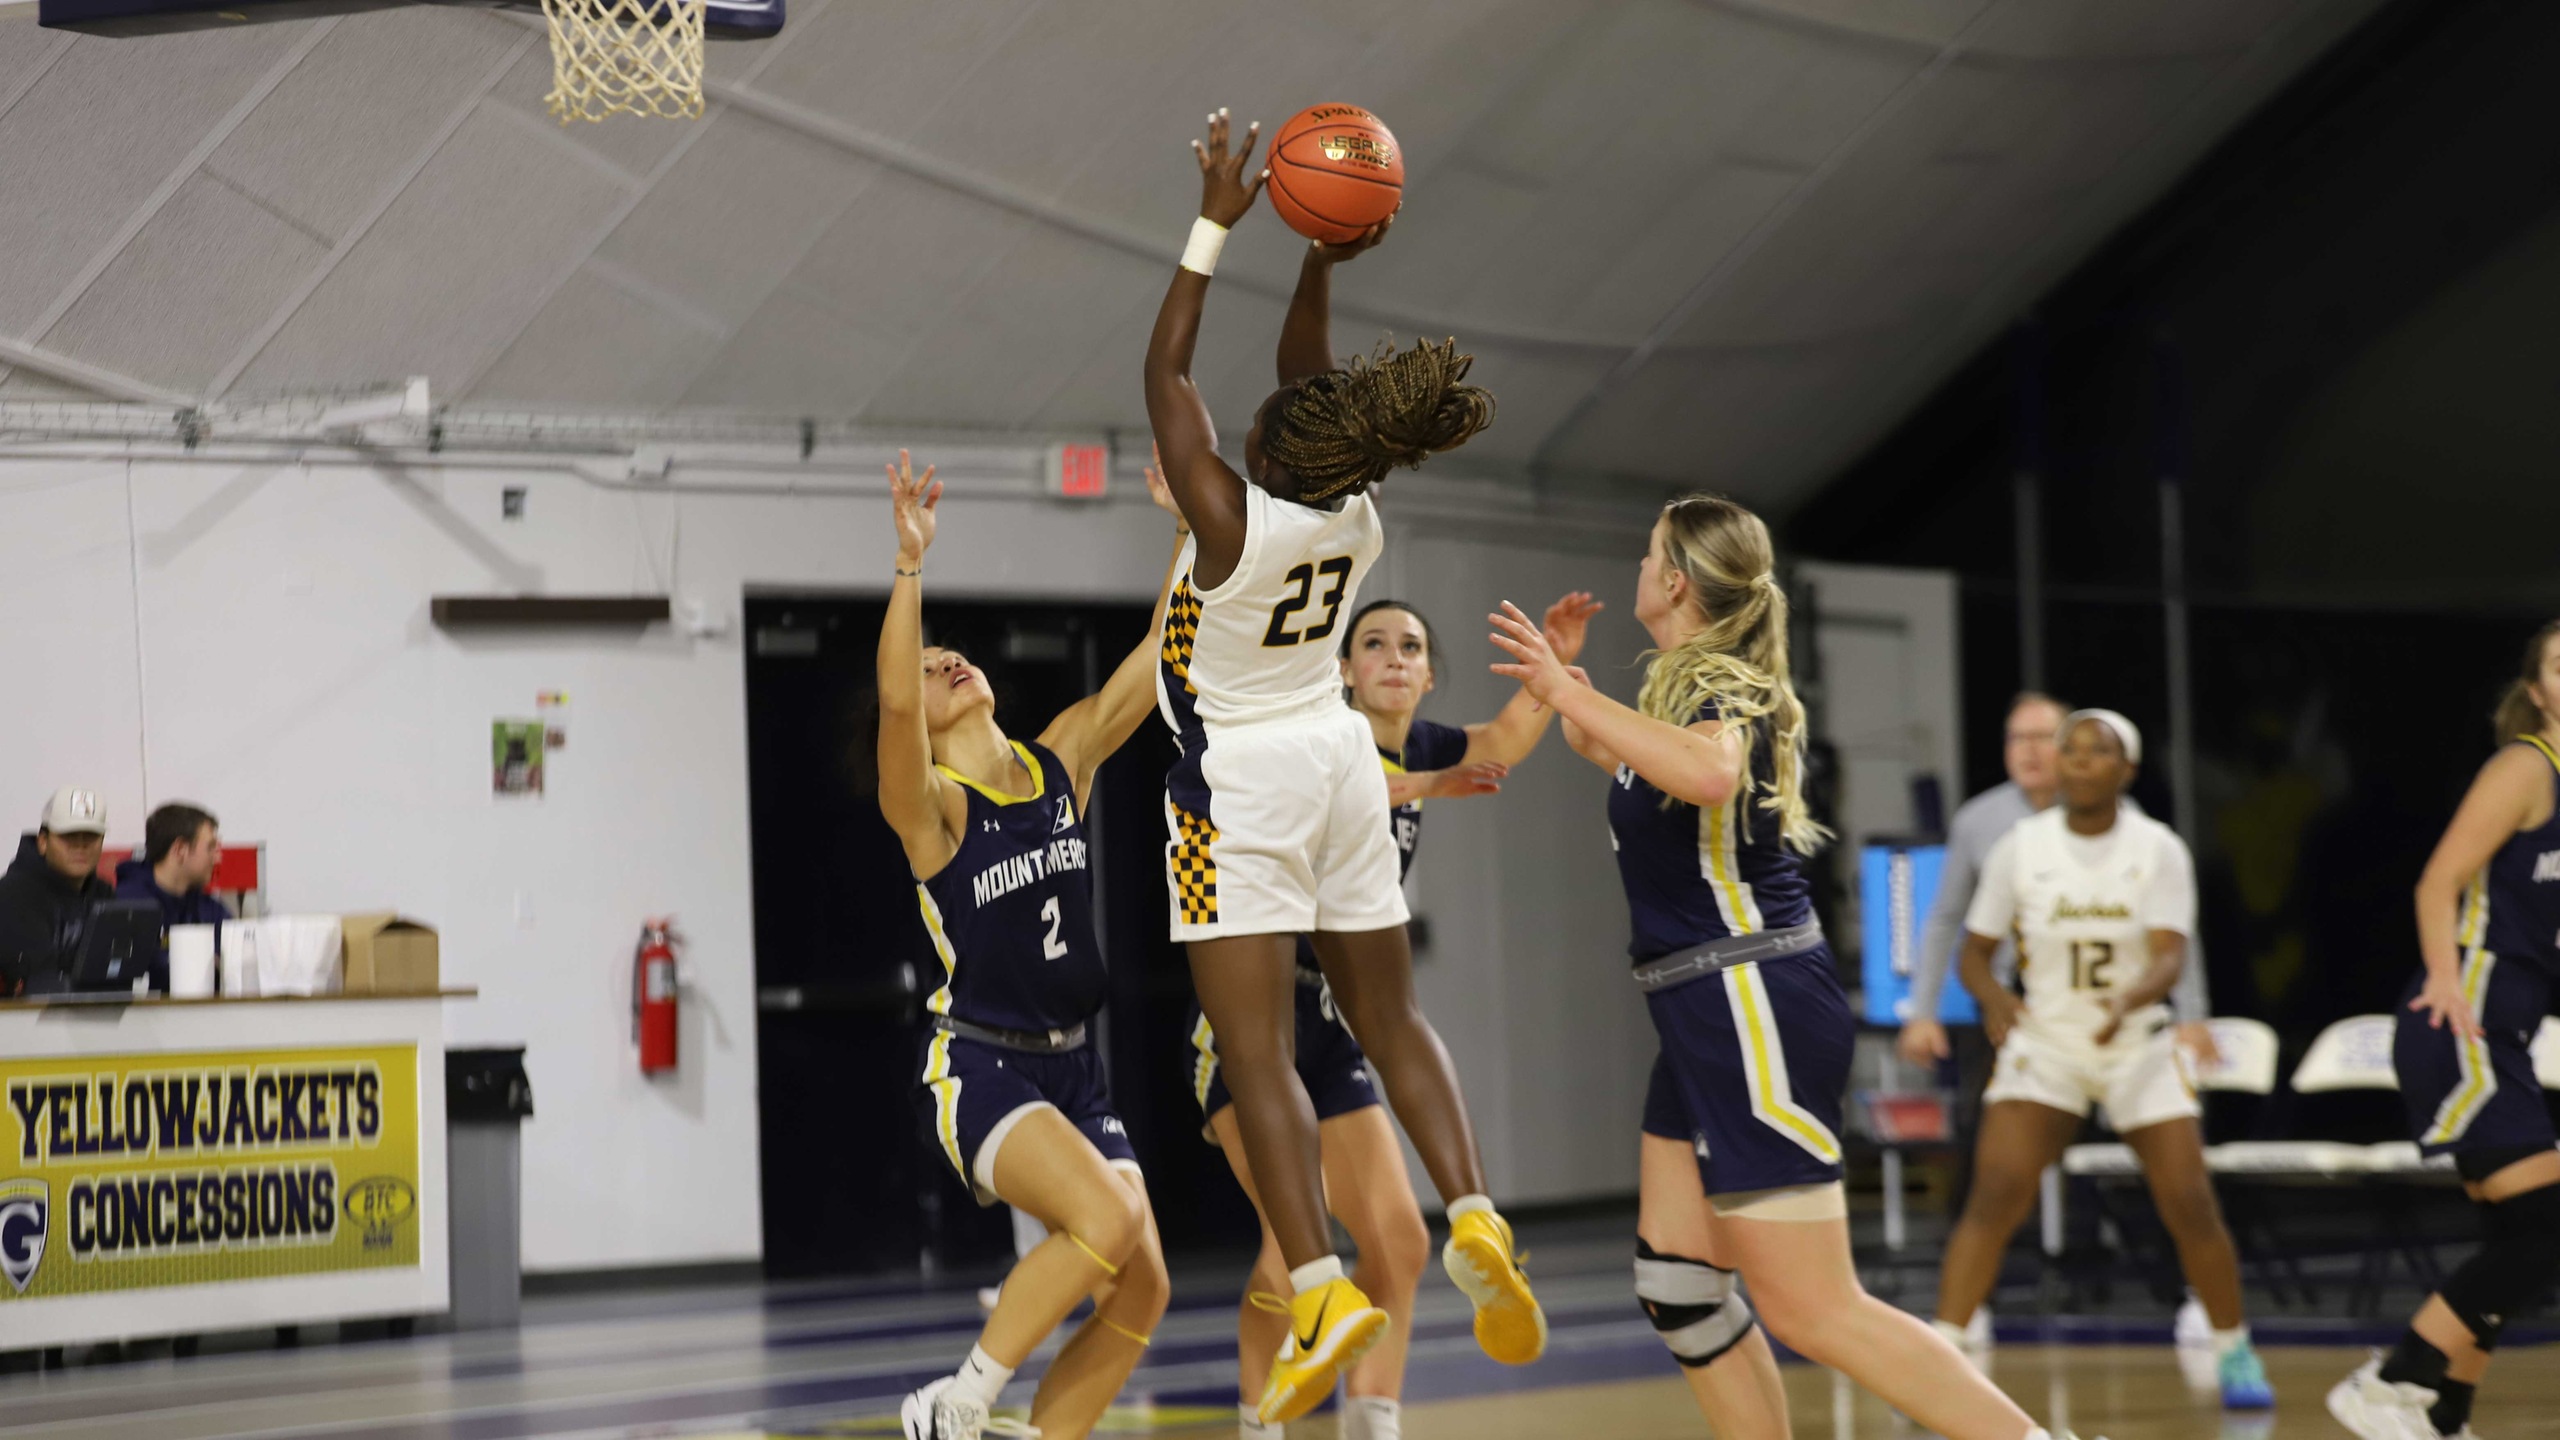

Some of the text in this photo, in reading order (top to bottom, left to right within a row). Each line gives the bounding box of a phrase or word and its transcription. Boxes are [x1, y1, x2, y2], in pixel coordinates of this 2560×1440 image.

[1260, 555, 1353, 647] 23
[973, 848, 1044, 909] MOUNT
[1041, 895, 1068, 961] 2
[2070, 941, 2112, 988] 12
[9, 1065, 380, 1164] YELLOWJACKETS
[69, 1166, 336, 1258] CONCESSIONS
